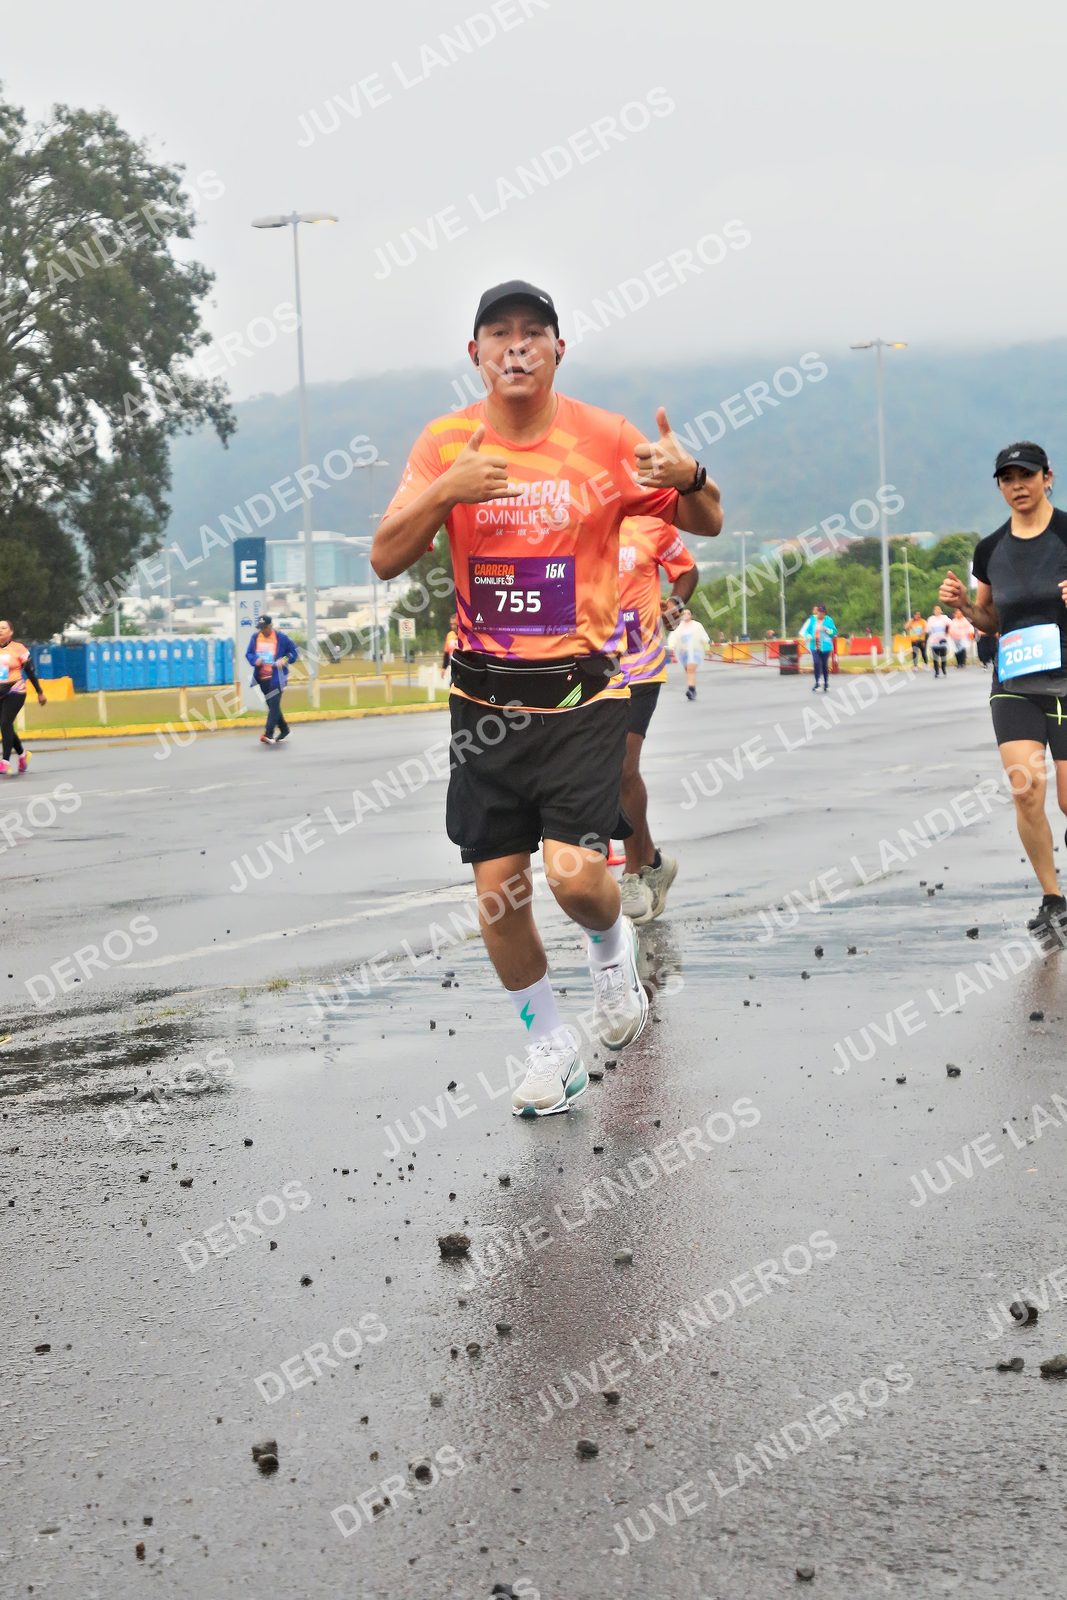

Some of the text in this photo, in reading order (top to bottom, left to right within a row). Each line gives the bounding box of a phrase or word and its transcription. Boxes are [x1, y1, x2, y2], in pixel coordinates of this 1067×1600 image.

[479, 480, 571, 507] RERA
[240, 559, 258, 585] E
[474, 563, 515, 576] CARRERA
[495, 590, 541, 613] 755
[1005, 644, 1044, 666] 2026
